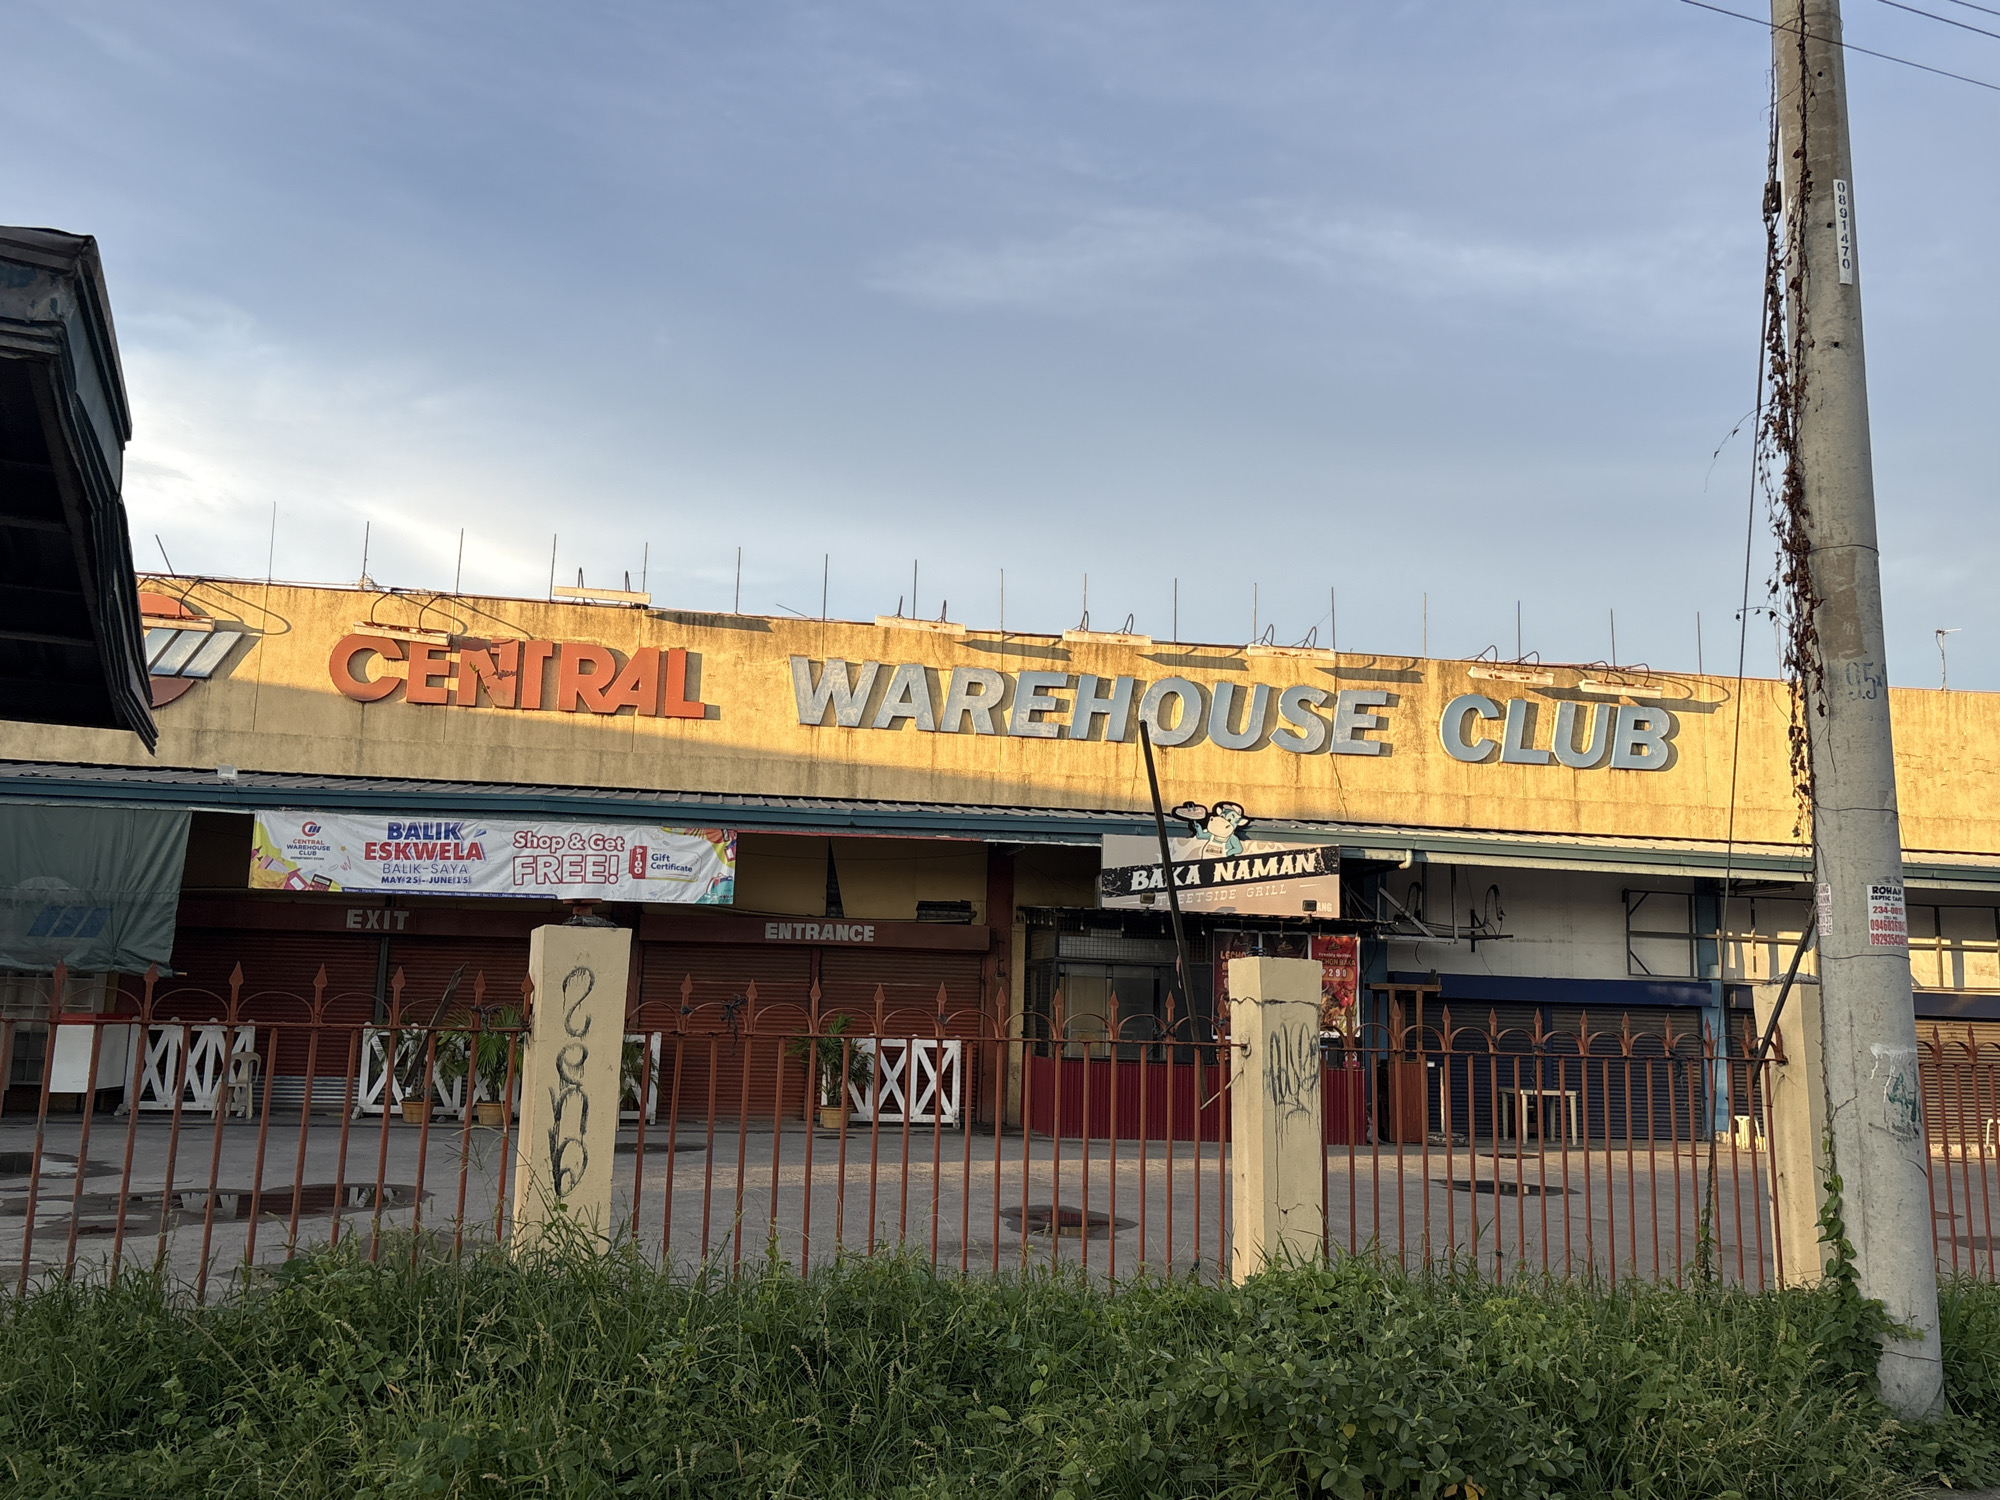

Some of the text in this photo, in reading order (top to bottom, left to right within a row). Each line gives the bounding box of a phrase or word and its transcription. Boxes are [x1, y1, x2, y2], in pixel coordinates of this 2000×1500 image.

[1837, 182, 1850, 269] 0891470
[329, 633, 1671, 770] CENTRAL WAREHOUSE CLUB
[387, 821, 462, 840] BALIK
[513, 830, 625, 851] Shop & Get
[364, 842, 484, 860] ESKWELA
[651, 853, 671, 862] Gift
[383, 863, 468, 874] BALIK-SAYA
[513, 854, 619, 886] FREE!
[651, 862, 693, 873] Certificate
[1130, 852, 1317, 891] BAKA NAMAN
[381, 876, 403, 884] MAY
[406, 876, 419, 884] 25
[428, 876, 454, 884] JUNE
[457, 876, 470, 884] 15
[1246, 884, 1287, 898] GRILL
[1317, 902, 1333, 912] ANG
[346, 909, 409, 930] EXIT
[764, 923, 875, 942] ENTRANCE
